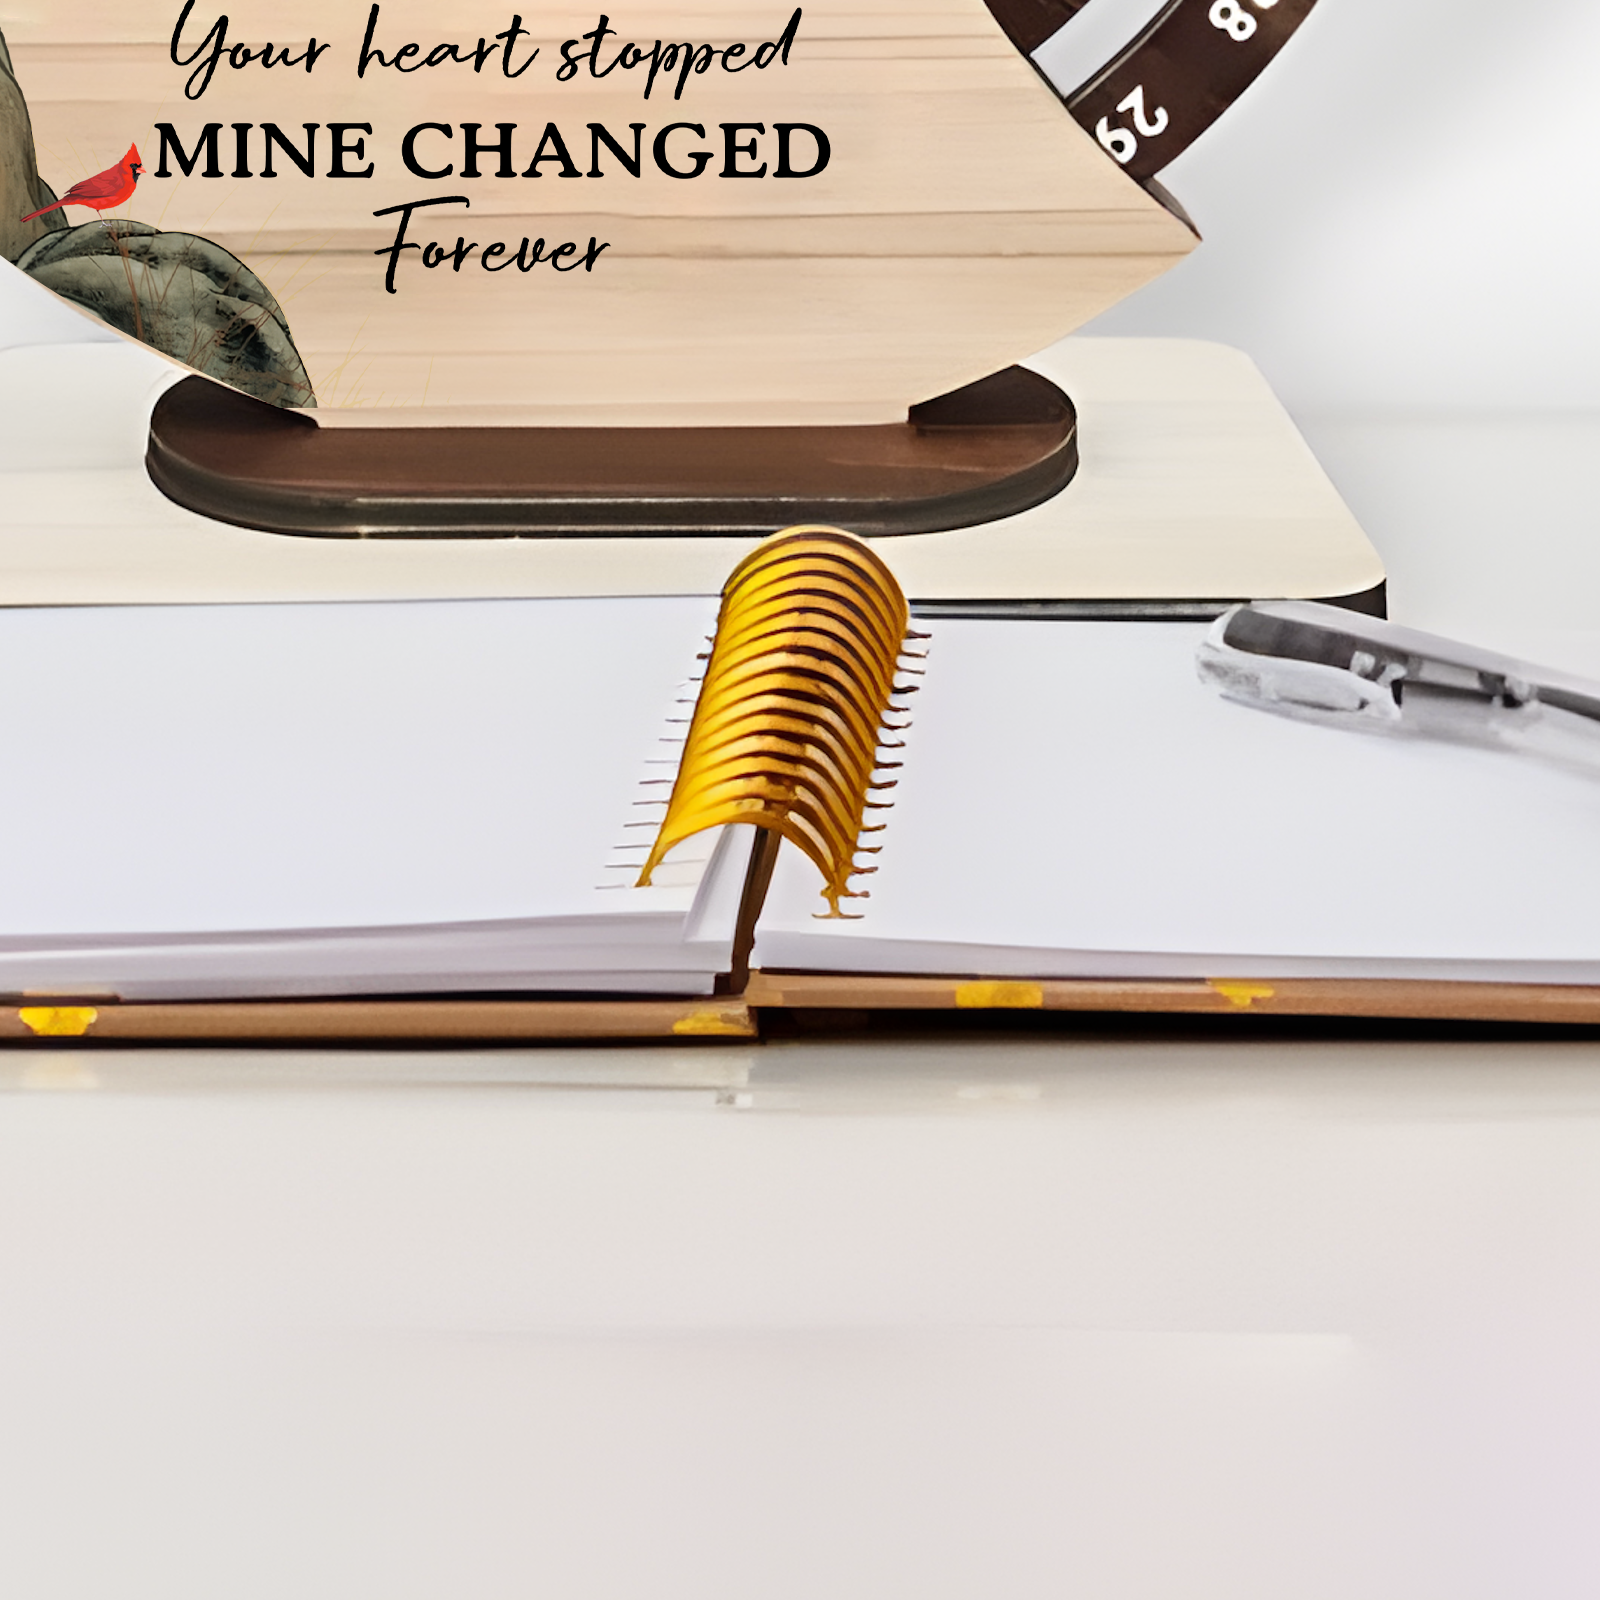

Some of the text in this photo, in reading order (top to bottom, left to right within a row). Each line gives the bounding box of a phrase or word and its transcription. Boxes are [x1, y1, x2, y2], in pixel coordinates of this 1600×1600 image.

[358, 4, 539, 78] heart
[557, 8, 802, 100] stopped
[154, 123, 830, 179] MINE CHANGED
[1095, 85, 1168, 163] 29
[373, 196, 610, 294] Forever
